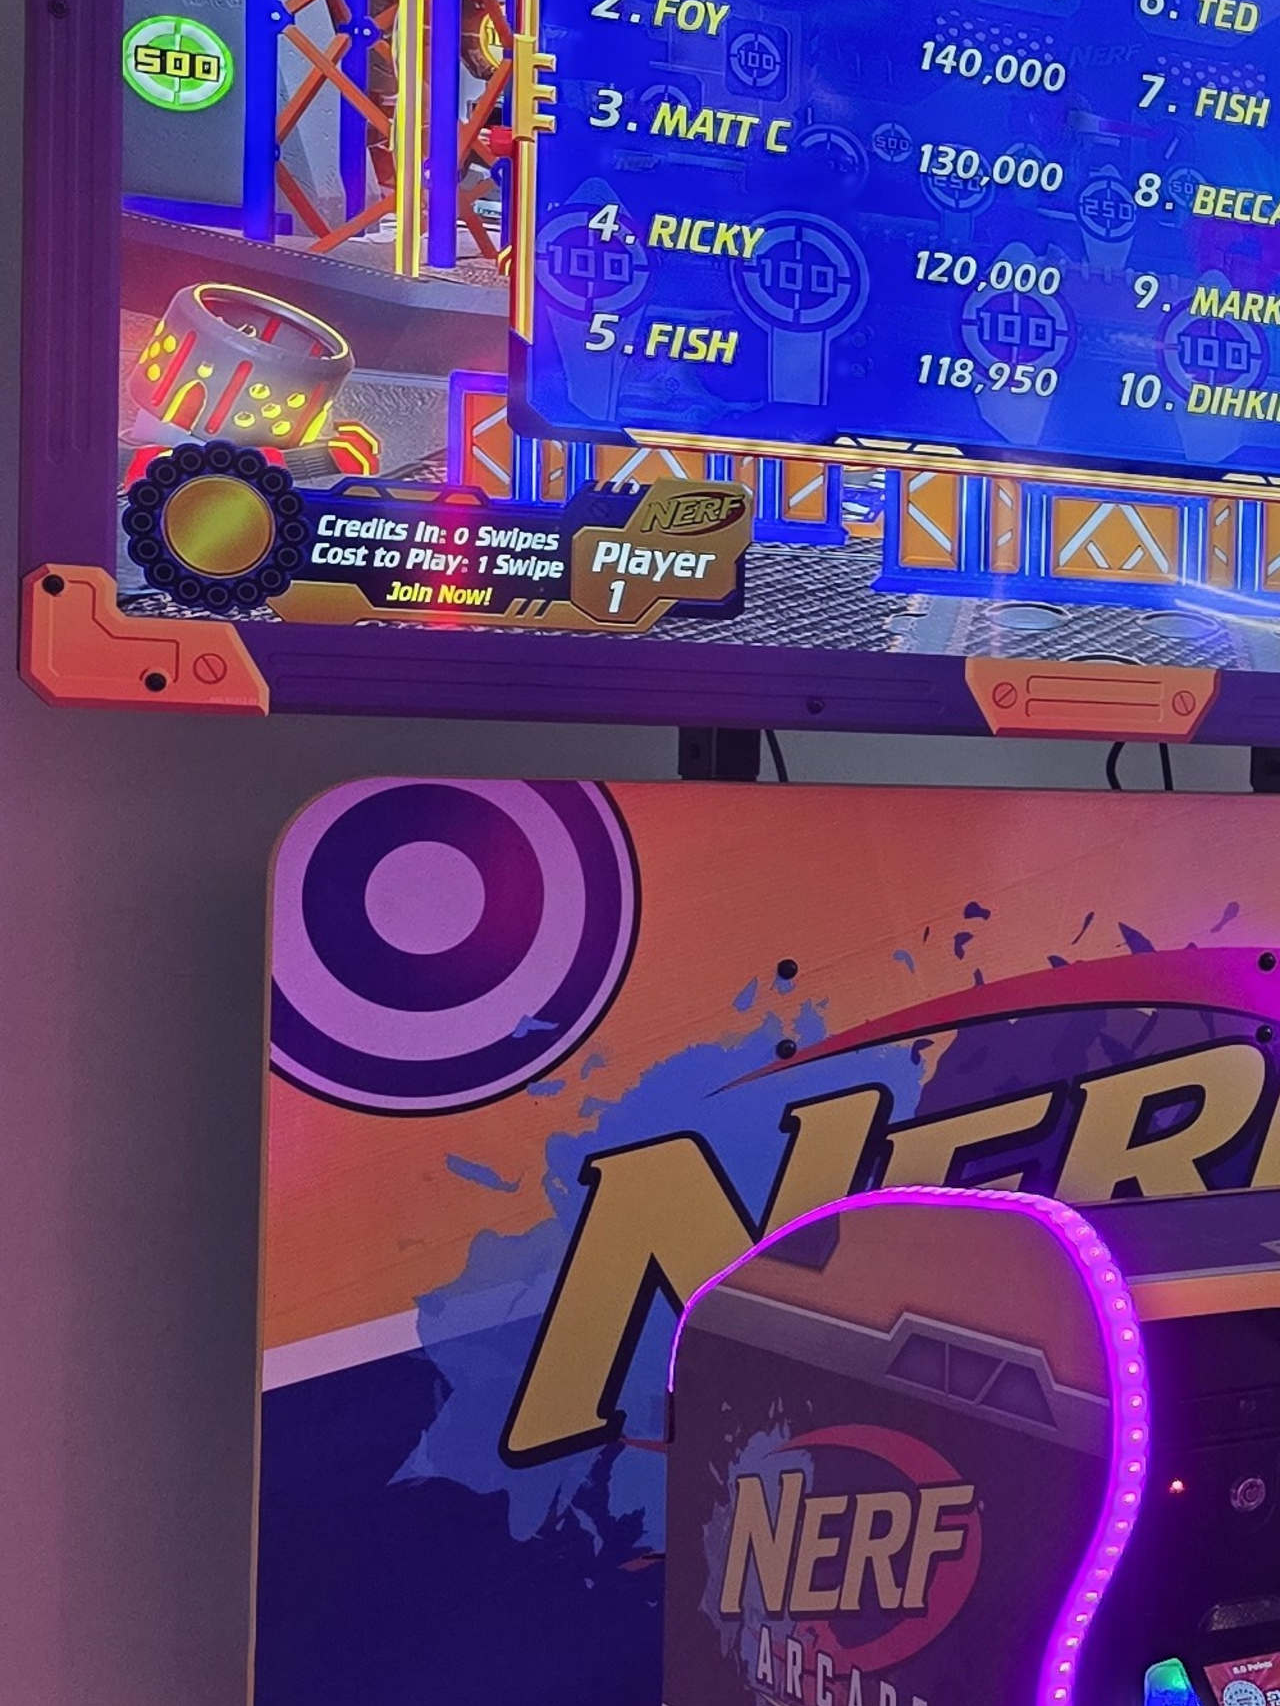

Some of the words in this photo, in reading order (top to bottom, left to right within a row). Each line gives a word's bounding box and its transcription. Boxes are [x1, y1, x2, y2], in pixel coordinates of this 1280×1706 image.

[135, 45, 221, 83] 500
[920, 40, 1067, 92] 140,000
[589, 89, 637, 133] 3.
[650, 102, 758, 147] MATT
[766, 119, 794, 154] C
[1138, 74, 1177, 113] 7.
[1194, 87, 1270, 128] FISH
[919, 142, 1064, 193] 130,000
[1135, 173, 1173, 211] 8.
[588, 204, 635, 247] 4.
[648, 214, 765, 260] RICKY
[915, 250, 1062, 296] 120,000
[1133, 275, 1172, 313] 9.
[584, 313, 633, 357] 5.
[645, 323, 739, 366] FISH
[917, 354, 1059, 397] 118,950
[1119, 372, 1174, 412] 10.
[316, 514, 409, 542] Credits
[414, 522, 447, 545] In:
[476, 525, 560, 552] Swipes
[641, 492, 747, 533] NERF
[311, 542, 368, 566] Cost
[372, 548, 400, 568] to
[406, 549, 469, 576] Play:
[494, 553, 565, 580] Swipe
[592, 541, 716, 581] Player
[386, 581, 431, 604] Join
[436, 583, 493, 607] Now!
[607, 580, 627, 613] 1
[719, 1470, 976, 1617] NERF
